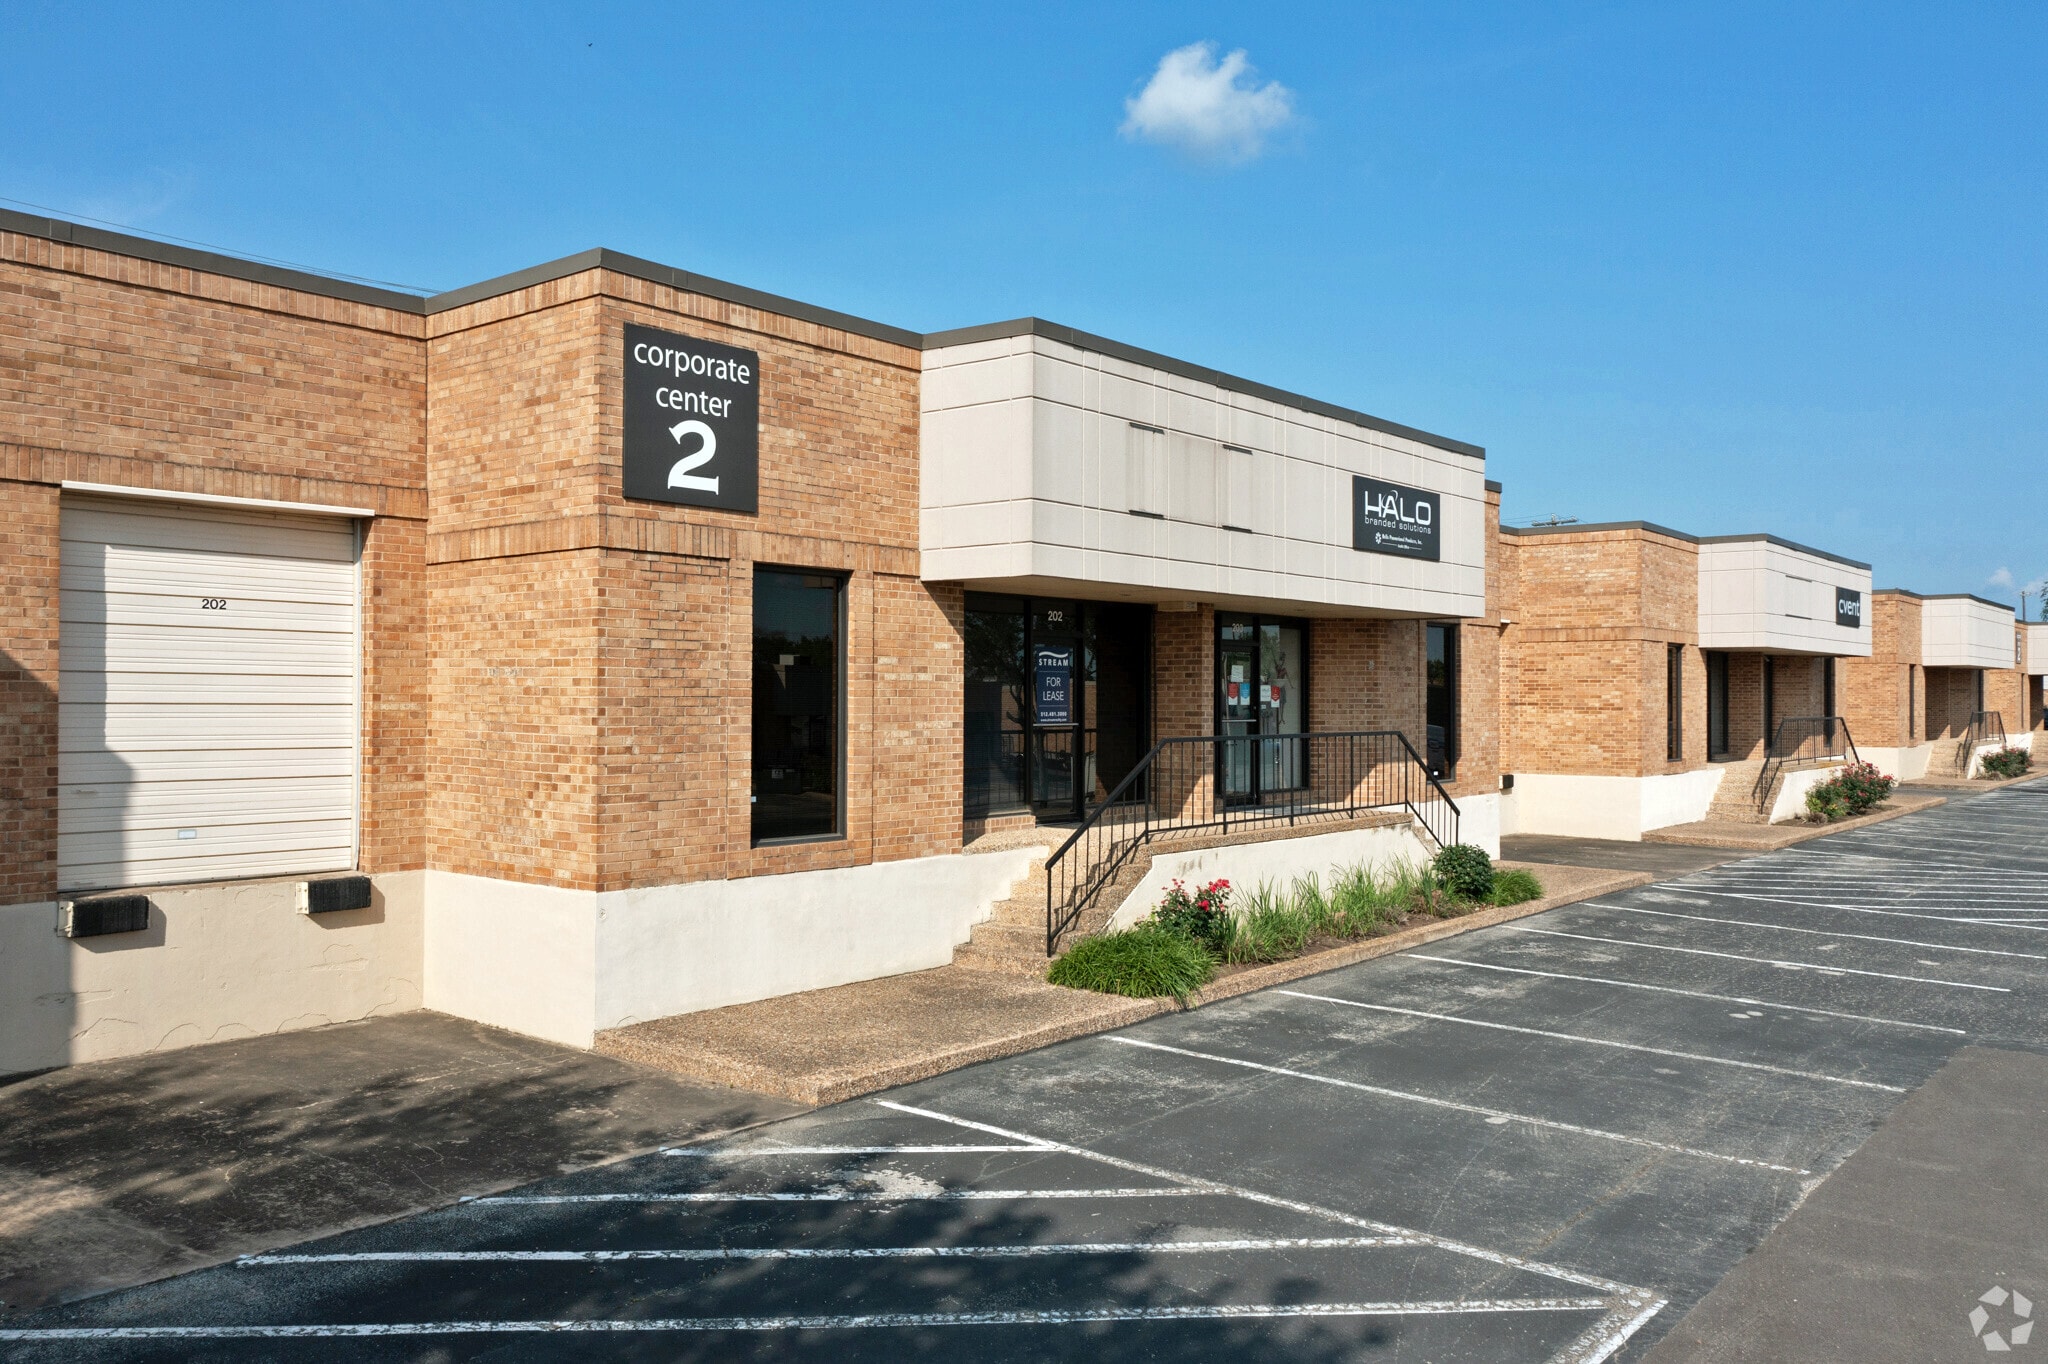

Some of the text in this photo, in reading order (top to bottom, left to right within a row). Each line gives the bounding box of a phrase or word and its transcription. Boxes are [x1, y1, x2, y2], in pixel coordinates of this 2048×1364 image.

[633, 343, 751, 385] corporate
[655, 387, 732, 418] center
[667, 419, 720, 496] 2
[1364, 490, 1432, 526] HALO
[1364, 515, 1432, 535] branded solutions
[201, 598, 227, 610] 202
[1838, 598, 1860, 617] cvent
[1047, 610, 1063, 622] 202
[1038, 658, 1069, 667] STREAM
[1046, 676, 1061, 687] FOR
[1042, 690, 1065, 701] LEASE
